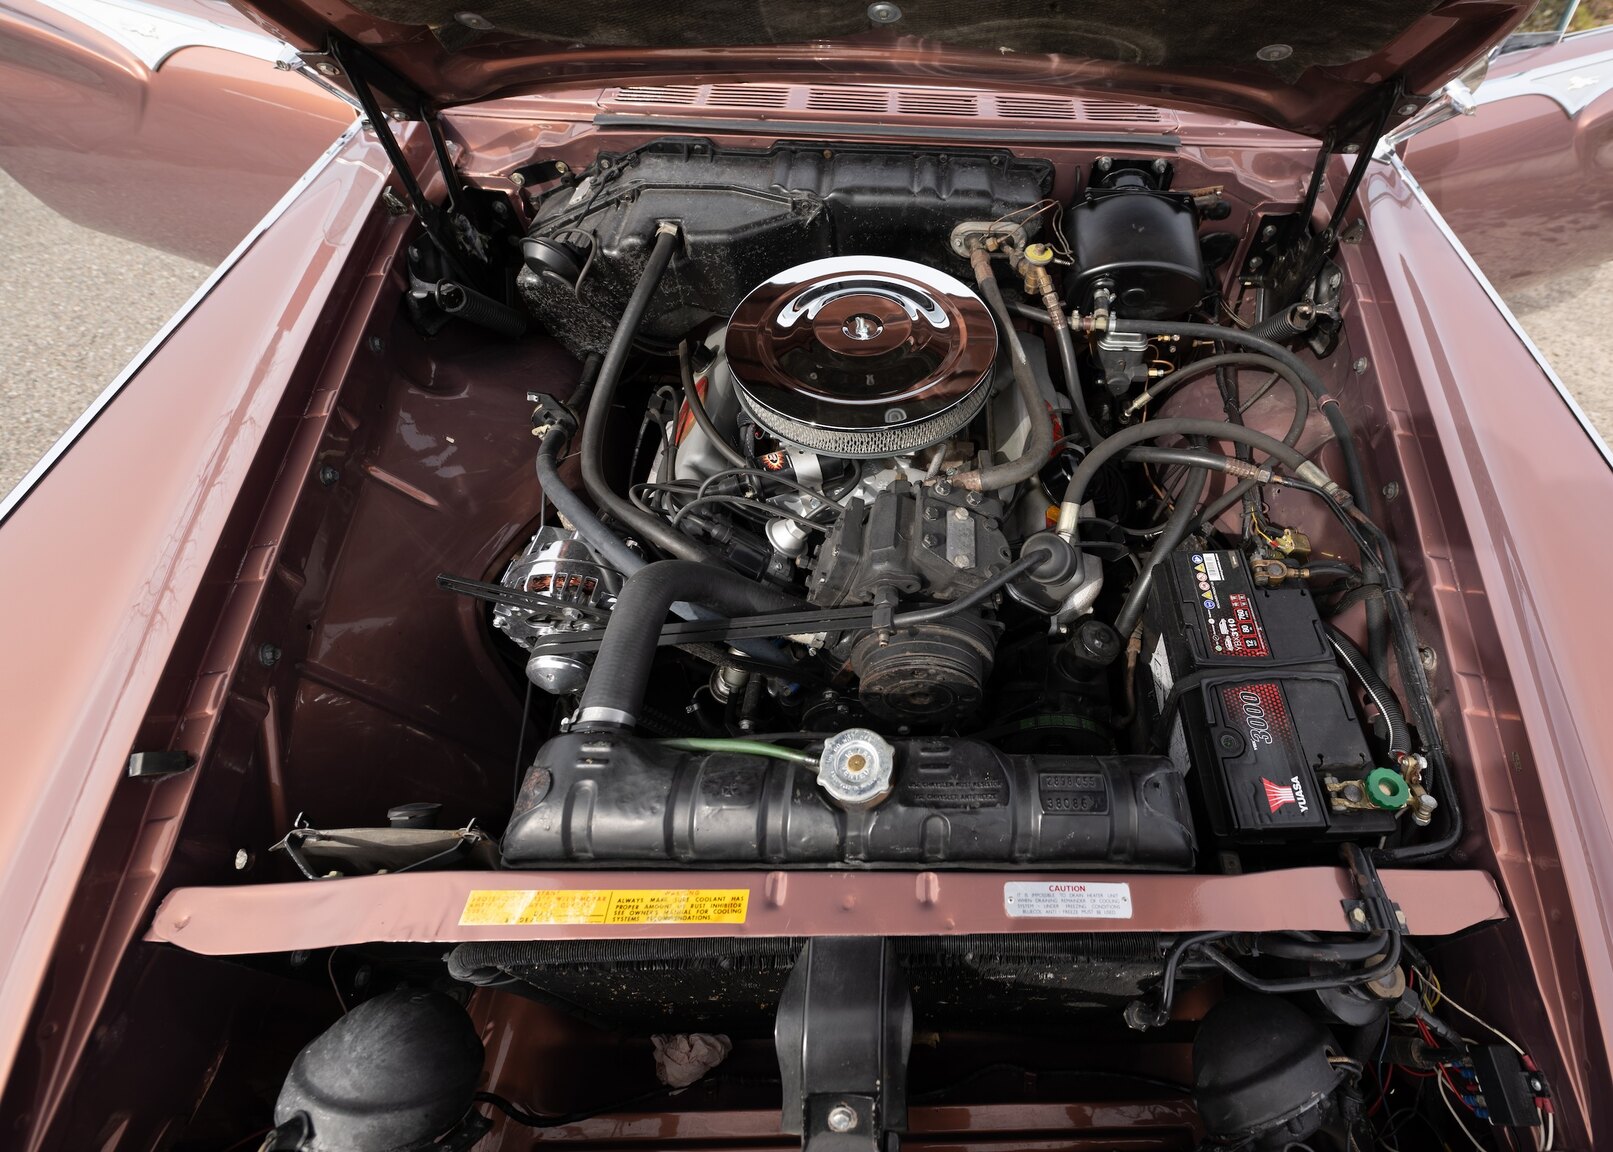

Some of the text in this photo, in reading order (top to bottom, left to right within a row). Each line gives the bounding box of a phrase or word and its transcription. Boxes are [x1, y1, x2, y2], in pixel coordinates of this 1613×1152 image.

[1245, 639, 1254, 647] 12
[1239, 691, 1273, 745] 3000
[1291, 775, 1309, 813] YUASA
